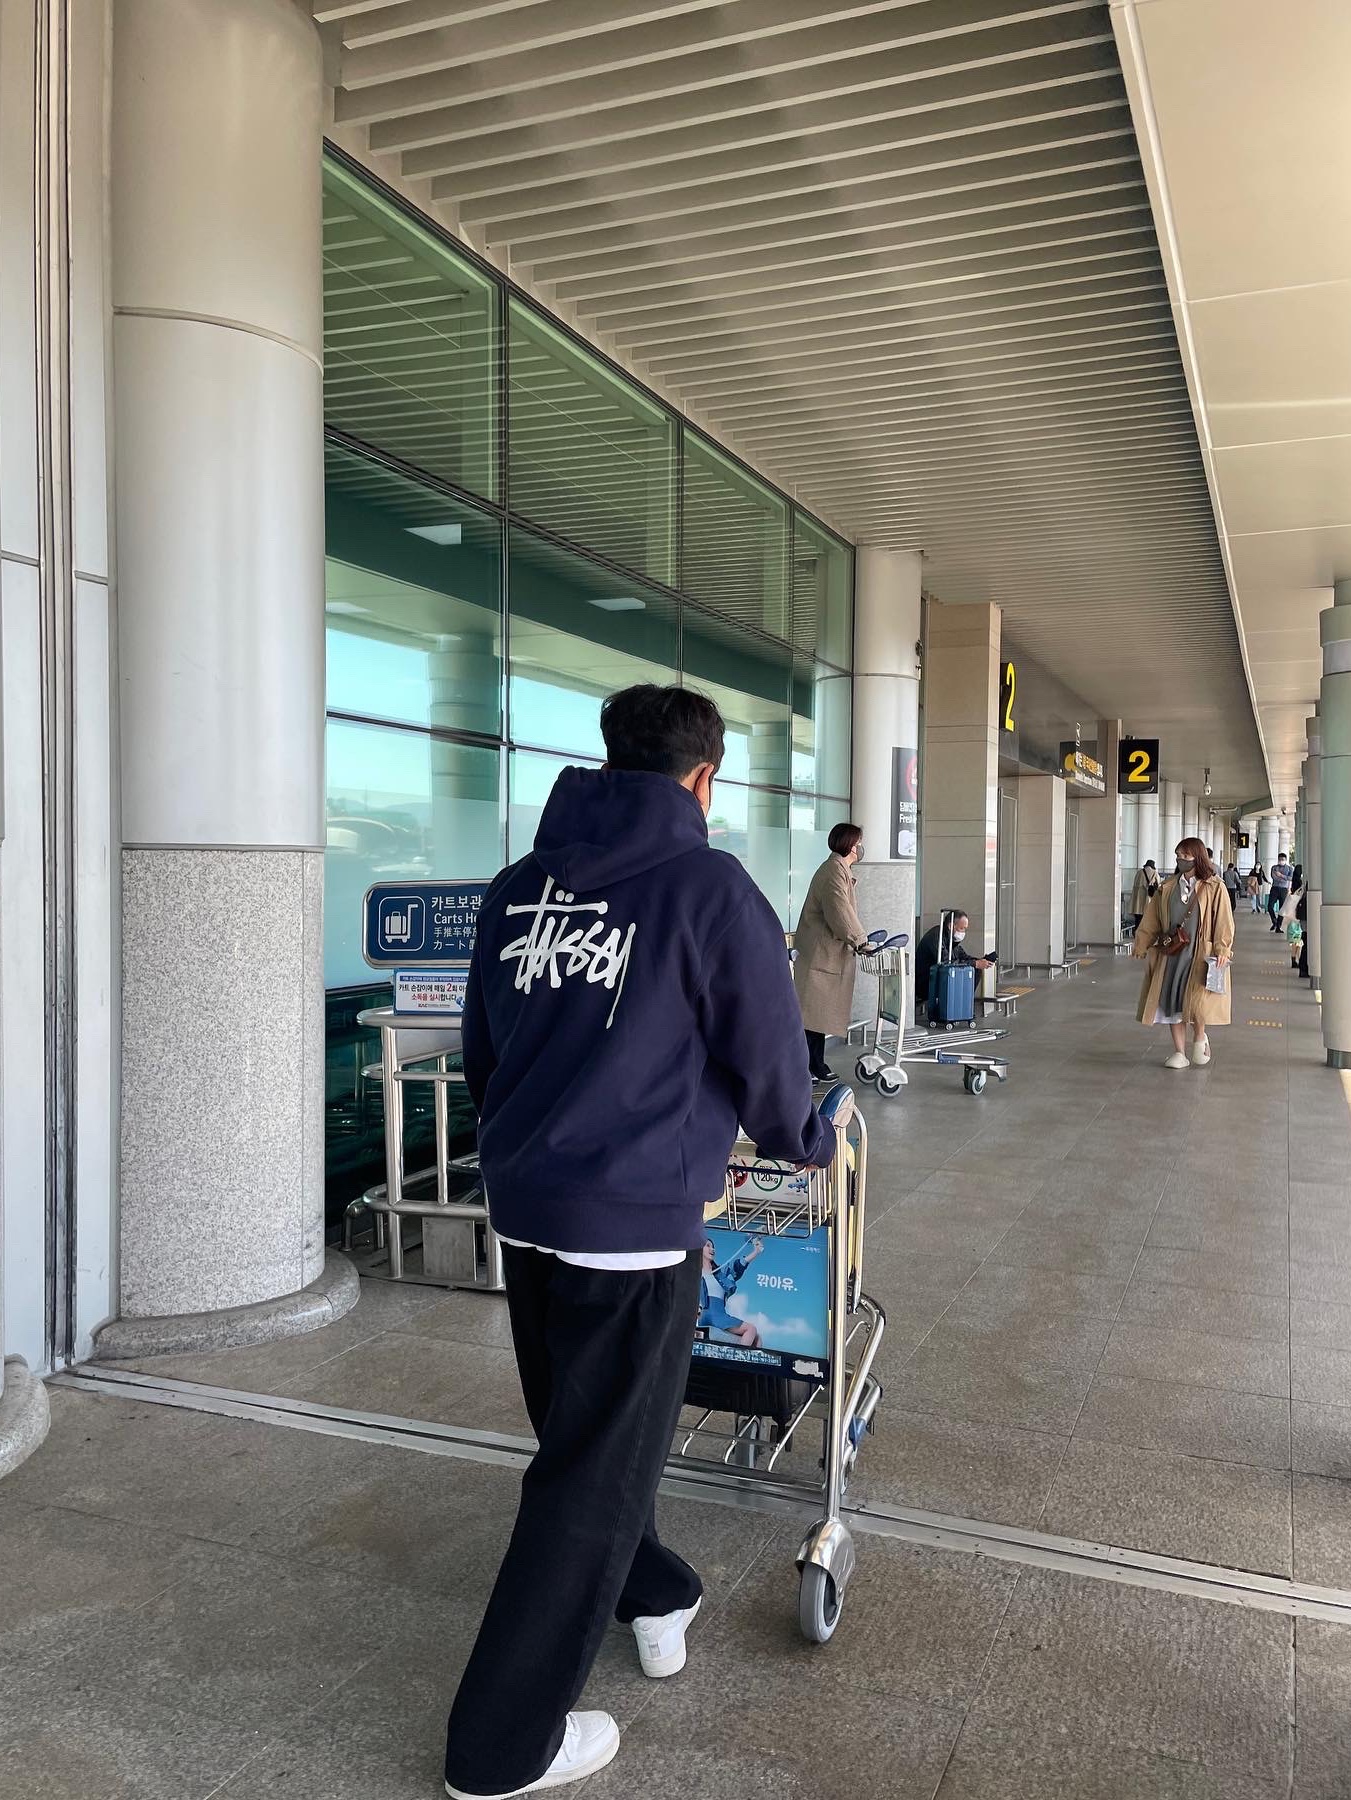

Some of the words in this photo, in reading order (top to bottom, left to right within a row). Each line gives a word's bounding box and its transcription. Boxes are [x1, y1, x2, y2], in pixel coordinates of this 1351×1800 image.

[1005, 662, 1017, 732] 2
[1128, 750, 1151, 783] 2
[1240, 835, 1247, 847] 1
[434, 912, 463, 924] Carts
[399, 984, 410, 992] 카트
